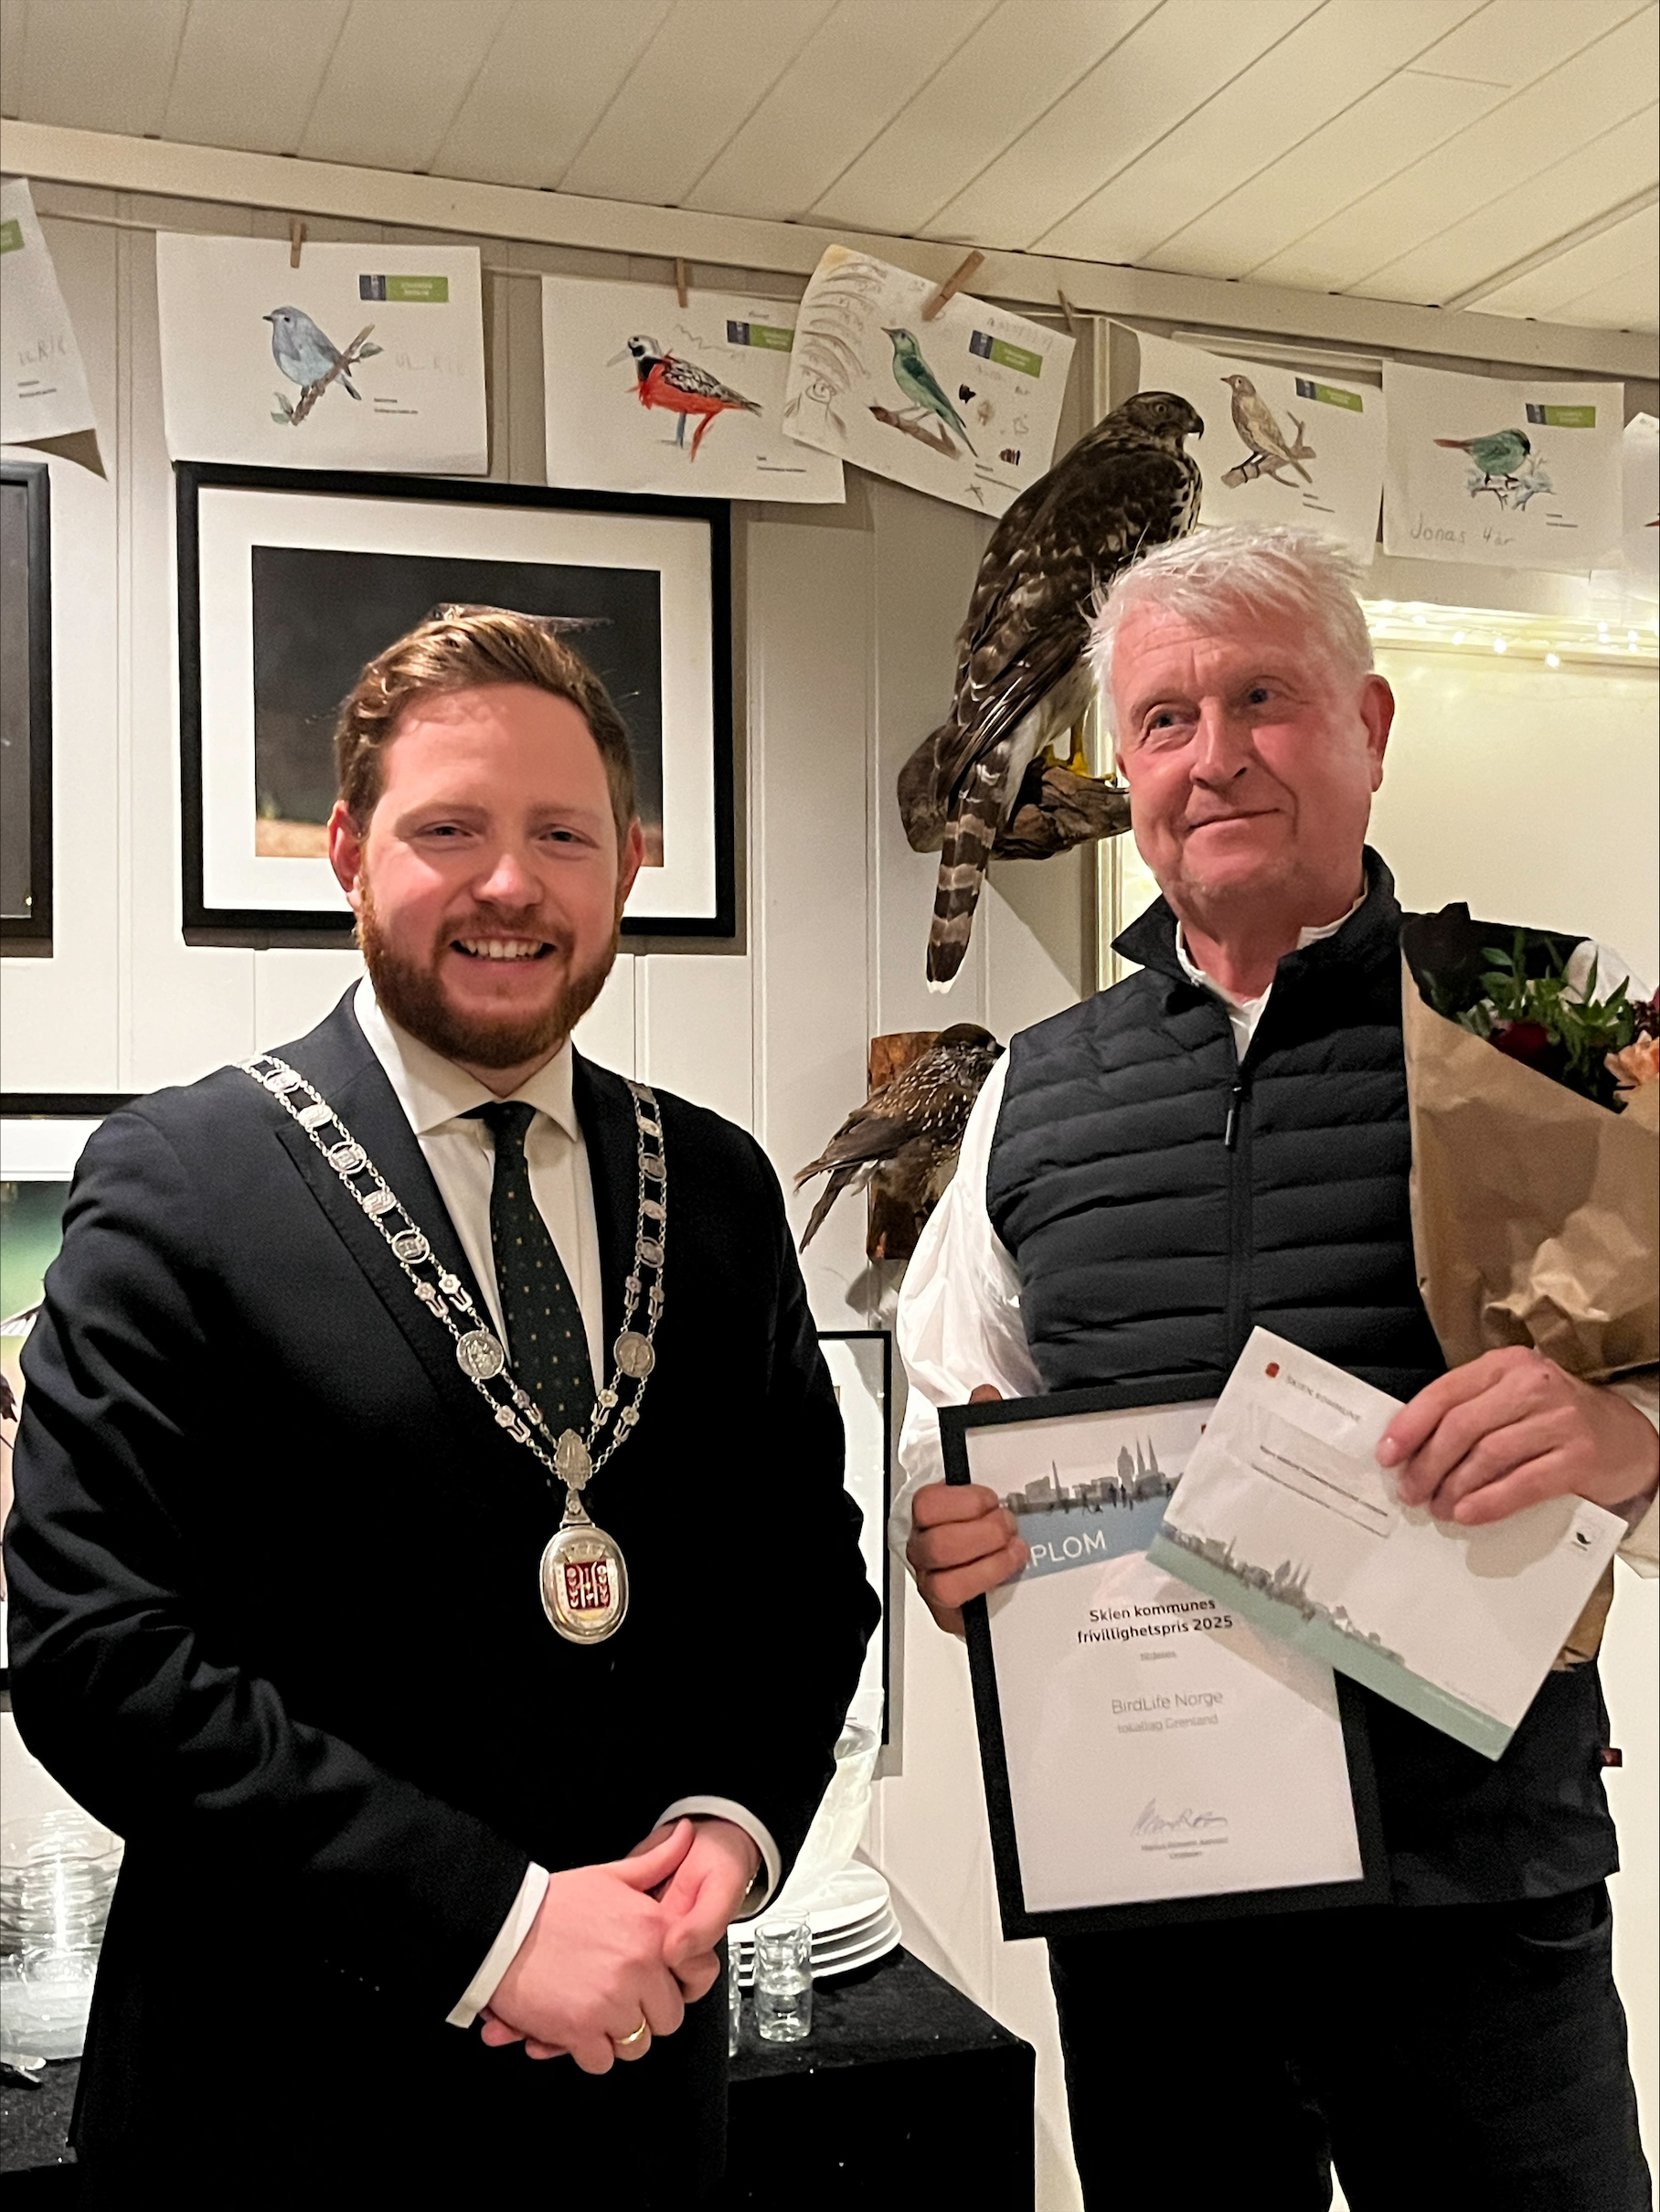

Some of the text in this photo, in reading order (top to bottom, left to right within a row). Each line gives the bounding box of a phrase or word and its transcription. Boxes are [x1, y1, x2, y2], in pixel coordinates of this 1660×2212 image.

[1410, 513, 1465, 544] Jonas
[1483, 526, 1493, 543] 4
[1026, 1529, 1107, 1569] PLOM
[1090, 1600, 1216, 1622] Skien kommunes
[1078, 1615, 1233, 1643] frivillighetspris 2025
[1112, 1692, 1224, 1715] BirdLife Norge
